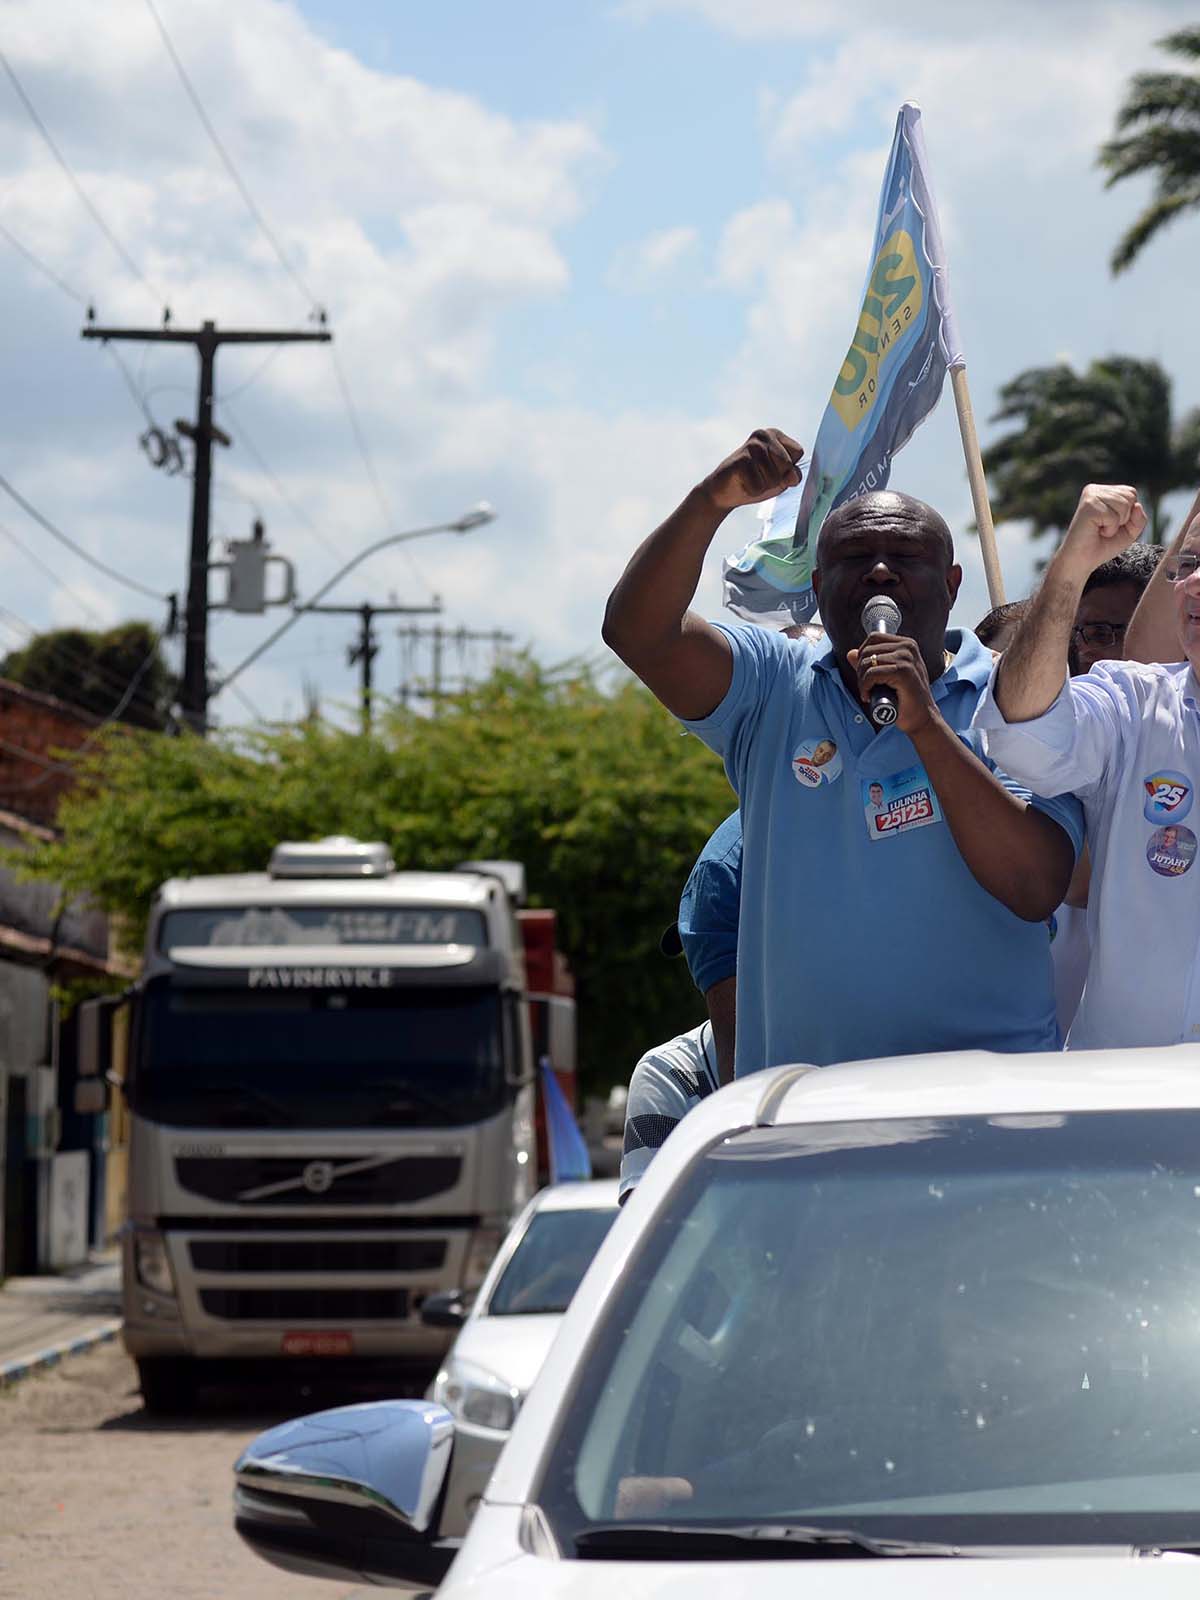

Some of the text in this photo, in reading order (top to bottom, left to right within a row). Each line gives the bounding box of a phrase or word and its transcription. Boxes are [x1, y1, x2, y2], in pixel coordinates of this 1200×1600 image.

[889, 791, 928, 811] LULINHA
[1152, 783, 1184, 806] 25
[880, 800, 929, 830] 25125
[1152, 852, 1190, 868] JUTAHY
